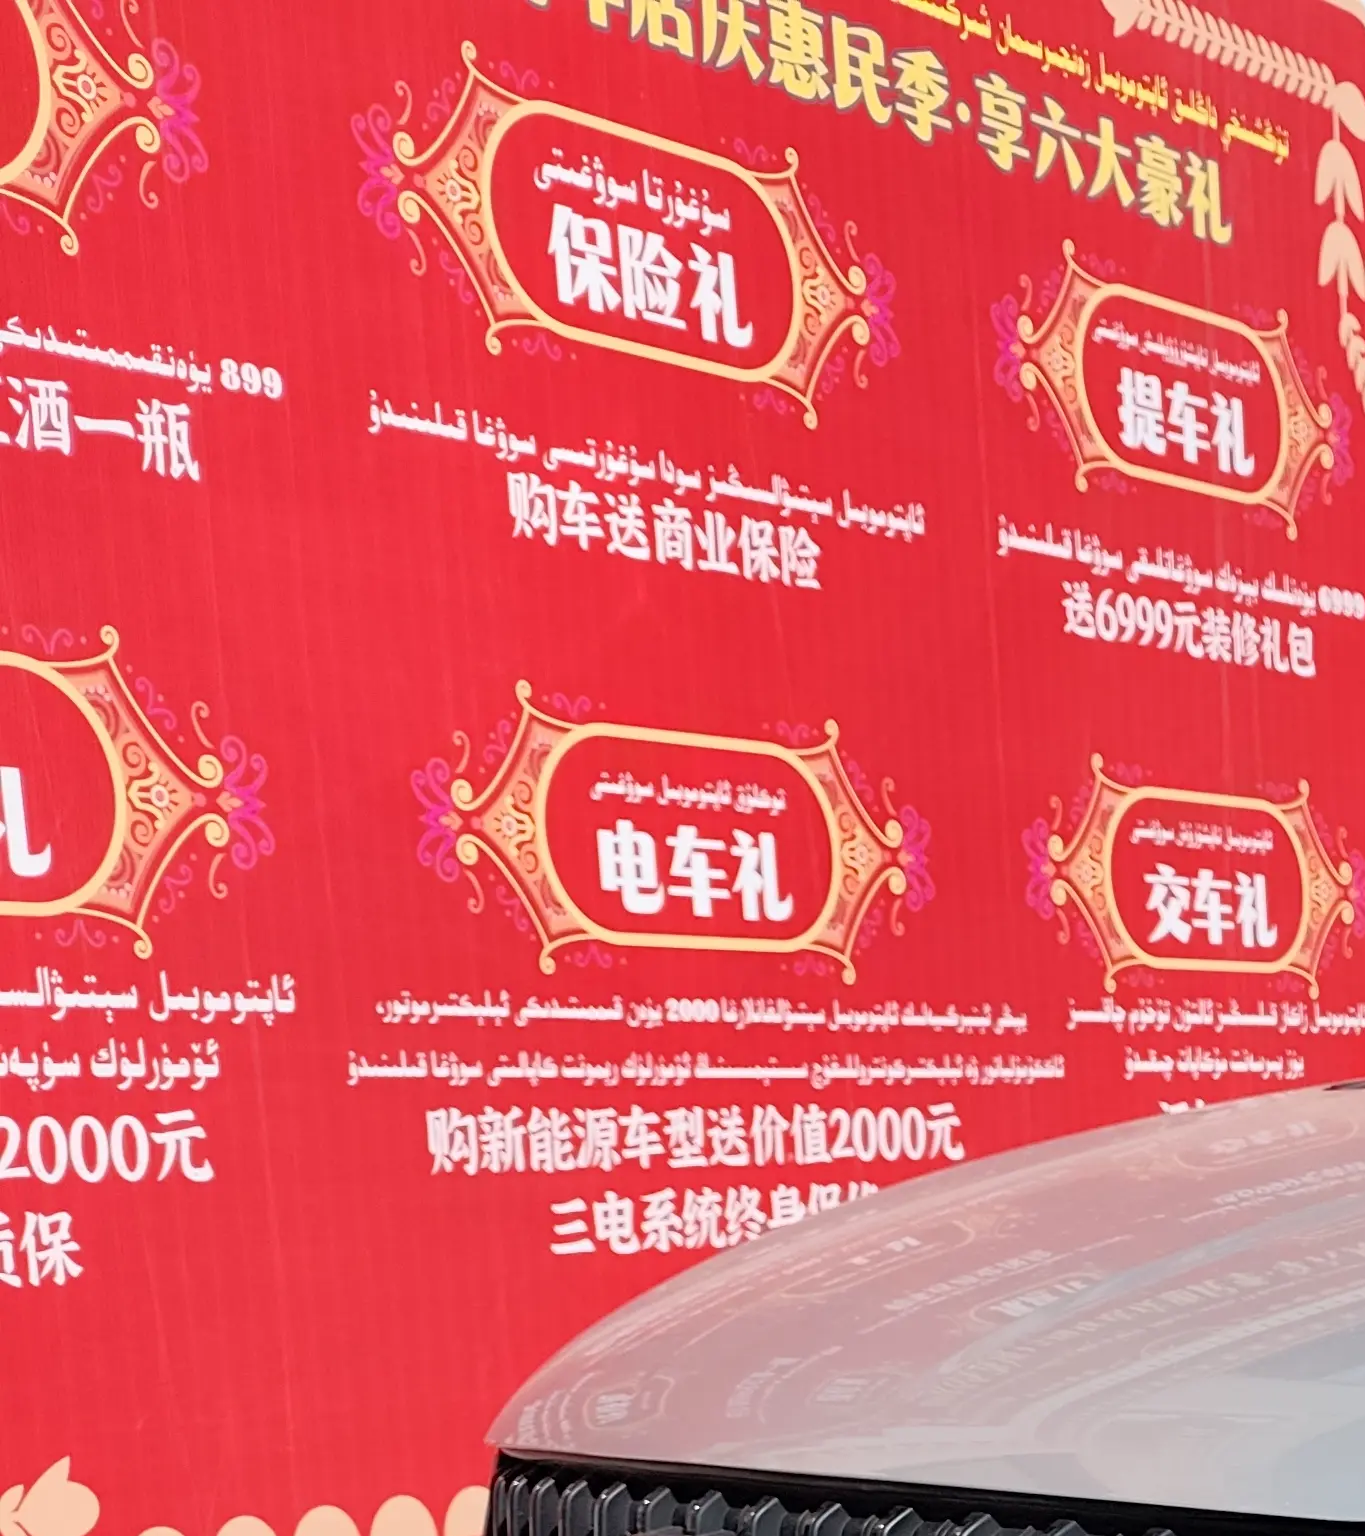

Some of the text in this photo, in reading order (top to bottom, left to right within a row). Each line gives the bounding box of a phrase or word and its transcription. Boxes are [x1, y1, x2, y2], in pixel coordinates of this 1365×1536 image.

[643, 169, 730, 236] سۇغۇرتا
[547, 203, 753, 348] 保险礼
[220, 358, 283, 399] 899
[0, 376, 200, 482] 酒一瓶
[472, 410, 536, 462] سوۋغا
[1117, 367, 1255, 477] 提车礼
[659, 450, 701, 496] سودا
[507, 471, 823, 589] 购车送商业保险
[837, 490, 924, 542] ئاپتوموبىل
[1062, 579, 1316, 677] 送6999元装修礼包
[597, 819, 793, 921] 电车礼
[1144, 863, 1278, 948] 交车礼
[149, 970, 296, 1026] ئاپتوموبىل
[665, 997, 720, 1022] 2000
[90, 1038, 220, 1090] ئۆمۈرلۈك
[0, 1109, 214, 1184] 2000元
[426, 1103, 965, 1176] 购新能源车型送价值2000元
